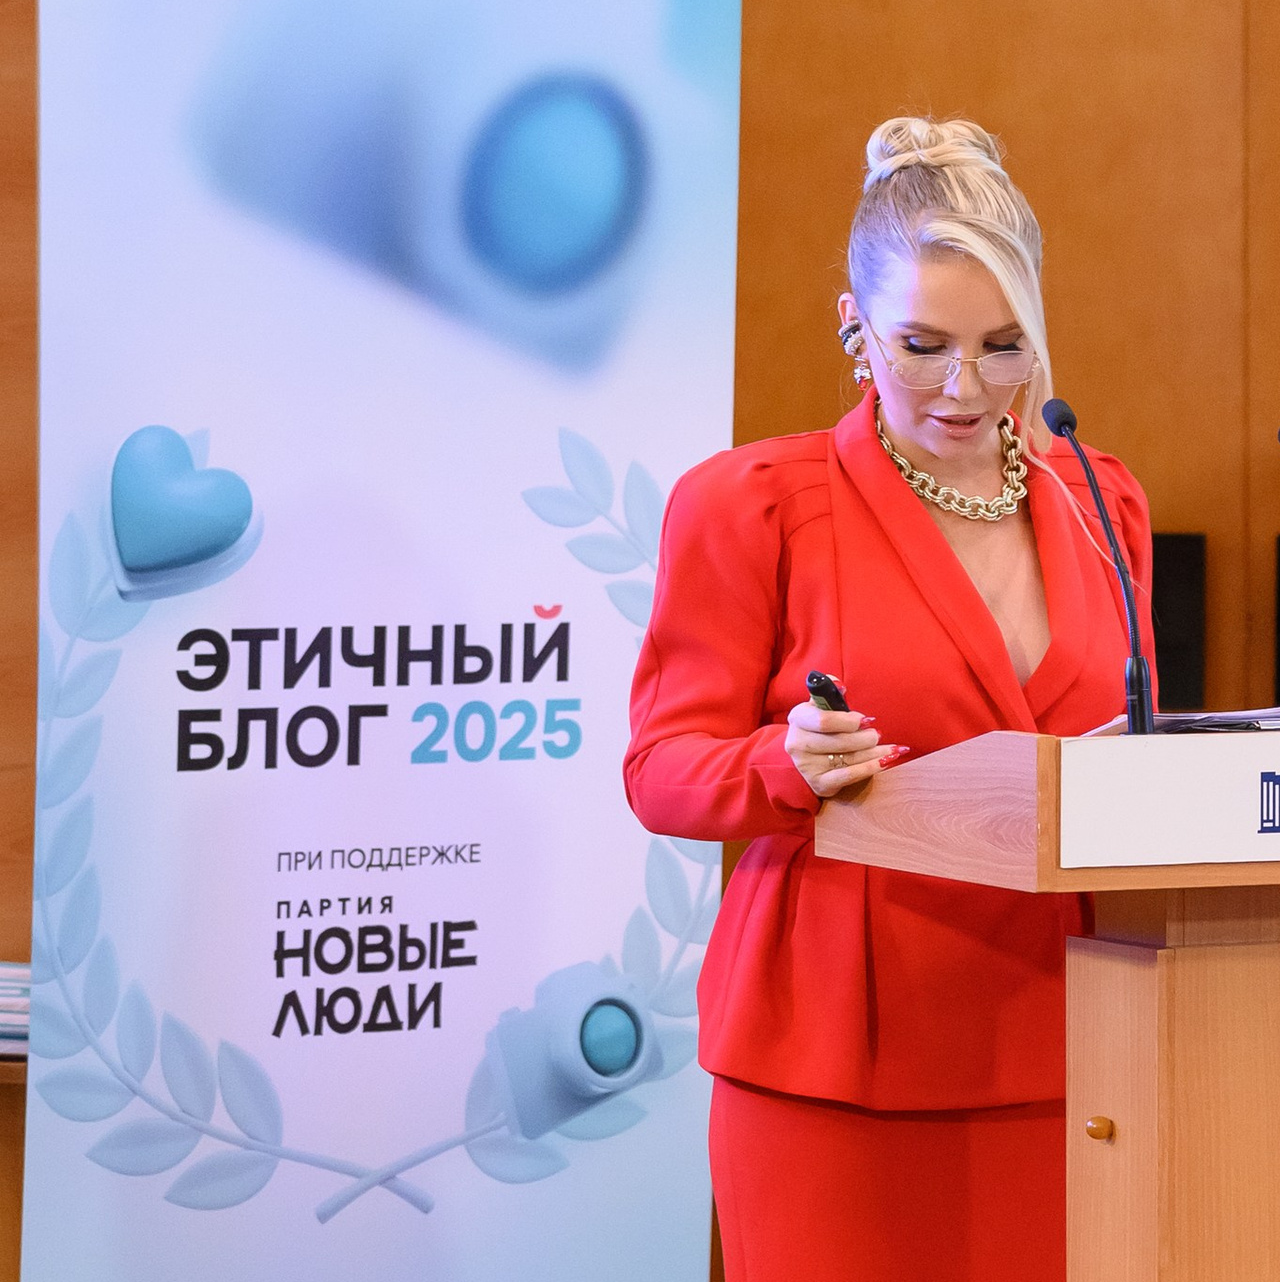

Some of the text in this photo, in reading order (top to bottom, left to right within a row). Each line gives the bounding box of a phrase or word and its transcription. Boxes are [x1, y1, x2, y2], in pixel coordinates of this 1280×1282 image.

[176, 604, 570, 692] ЭТИЧНЫЙ
[176, 699, 582, 772] БЛОГ 2025
[277, 843, 482, 872] ПРИ ПОДДЕРЖКЕ
[276, 895, 393, 919] ПАРТИЯ
[273, 920, 477, 978] НОВЫЕ
[271, 981, 443, 1038] ЛЮДИ
